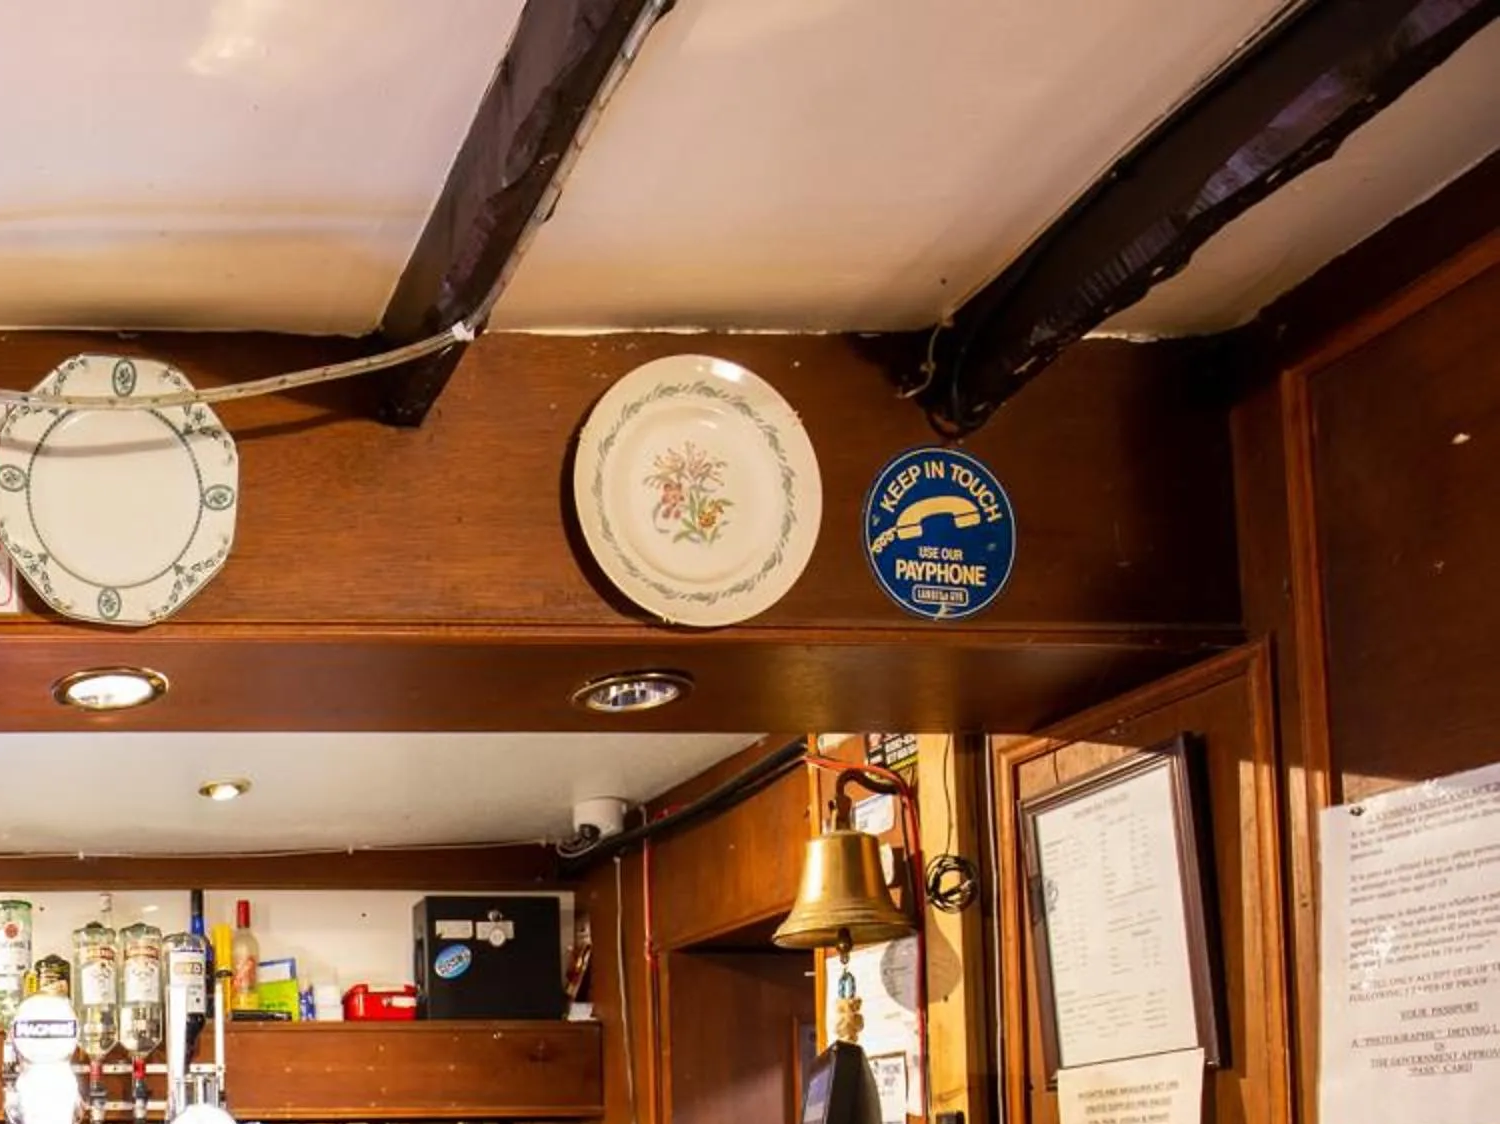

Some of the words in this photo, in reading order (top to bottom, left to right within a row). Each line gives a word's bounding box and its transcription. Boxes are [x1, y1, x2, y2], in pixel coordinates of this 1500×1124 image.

[880, 465, 921, 513] KEEP
[924, 460, 945, 479] IN
[950, 463, 1003, 523] TOUCH
[919, 546, 939, 559] USE
[941, 547, 964, 561] OUR
[895, 559, 987, 586] PAYPHONE
